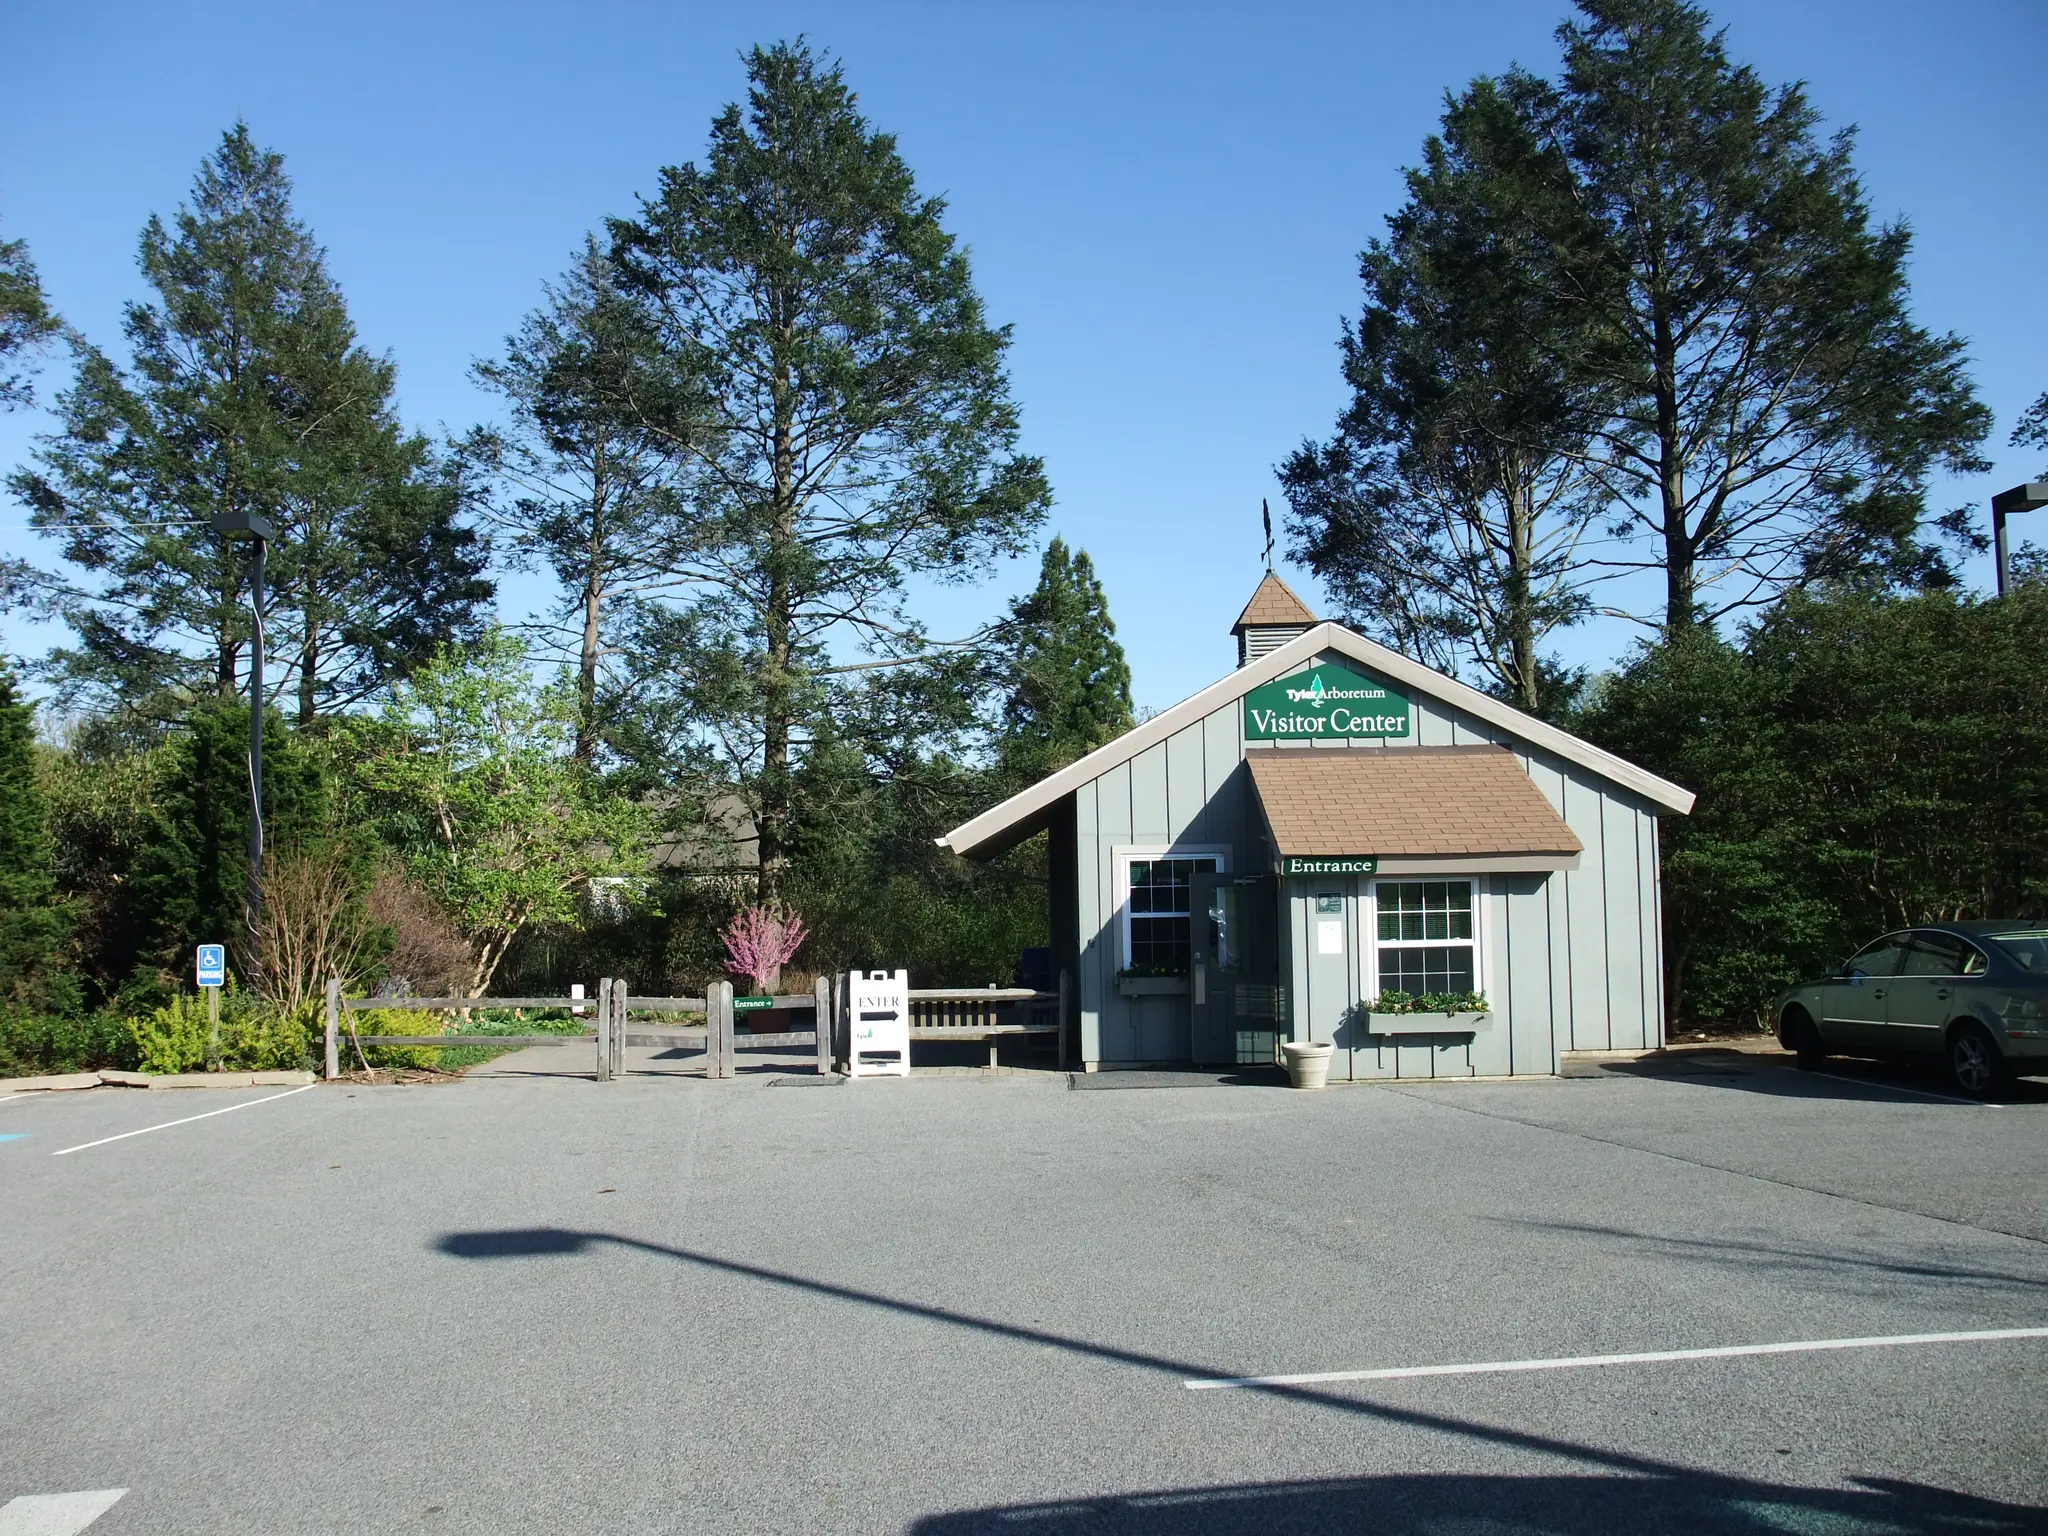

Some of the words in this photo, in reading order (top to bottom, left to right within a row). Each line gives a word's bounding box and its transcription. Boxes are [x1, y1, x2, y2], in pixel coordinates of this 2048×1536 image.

[1319, 686, 1385, 699] Arboretum
[1251, 709, 1326, 733] Visitor
[1331, 708, 1405, 732] Center
[1290, 859, 1372, 872] Entrance
[734, 1000, 765, 1008] Entrance
[859, 996, 899, 1007] ENTER
